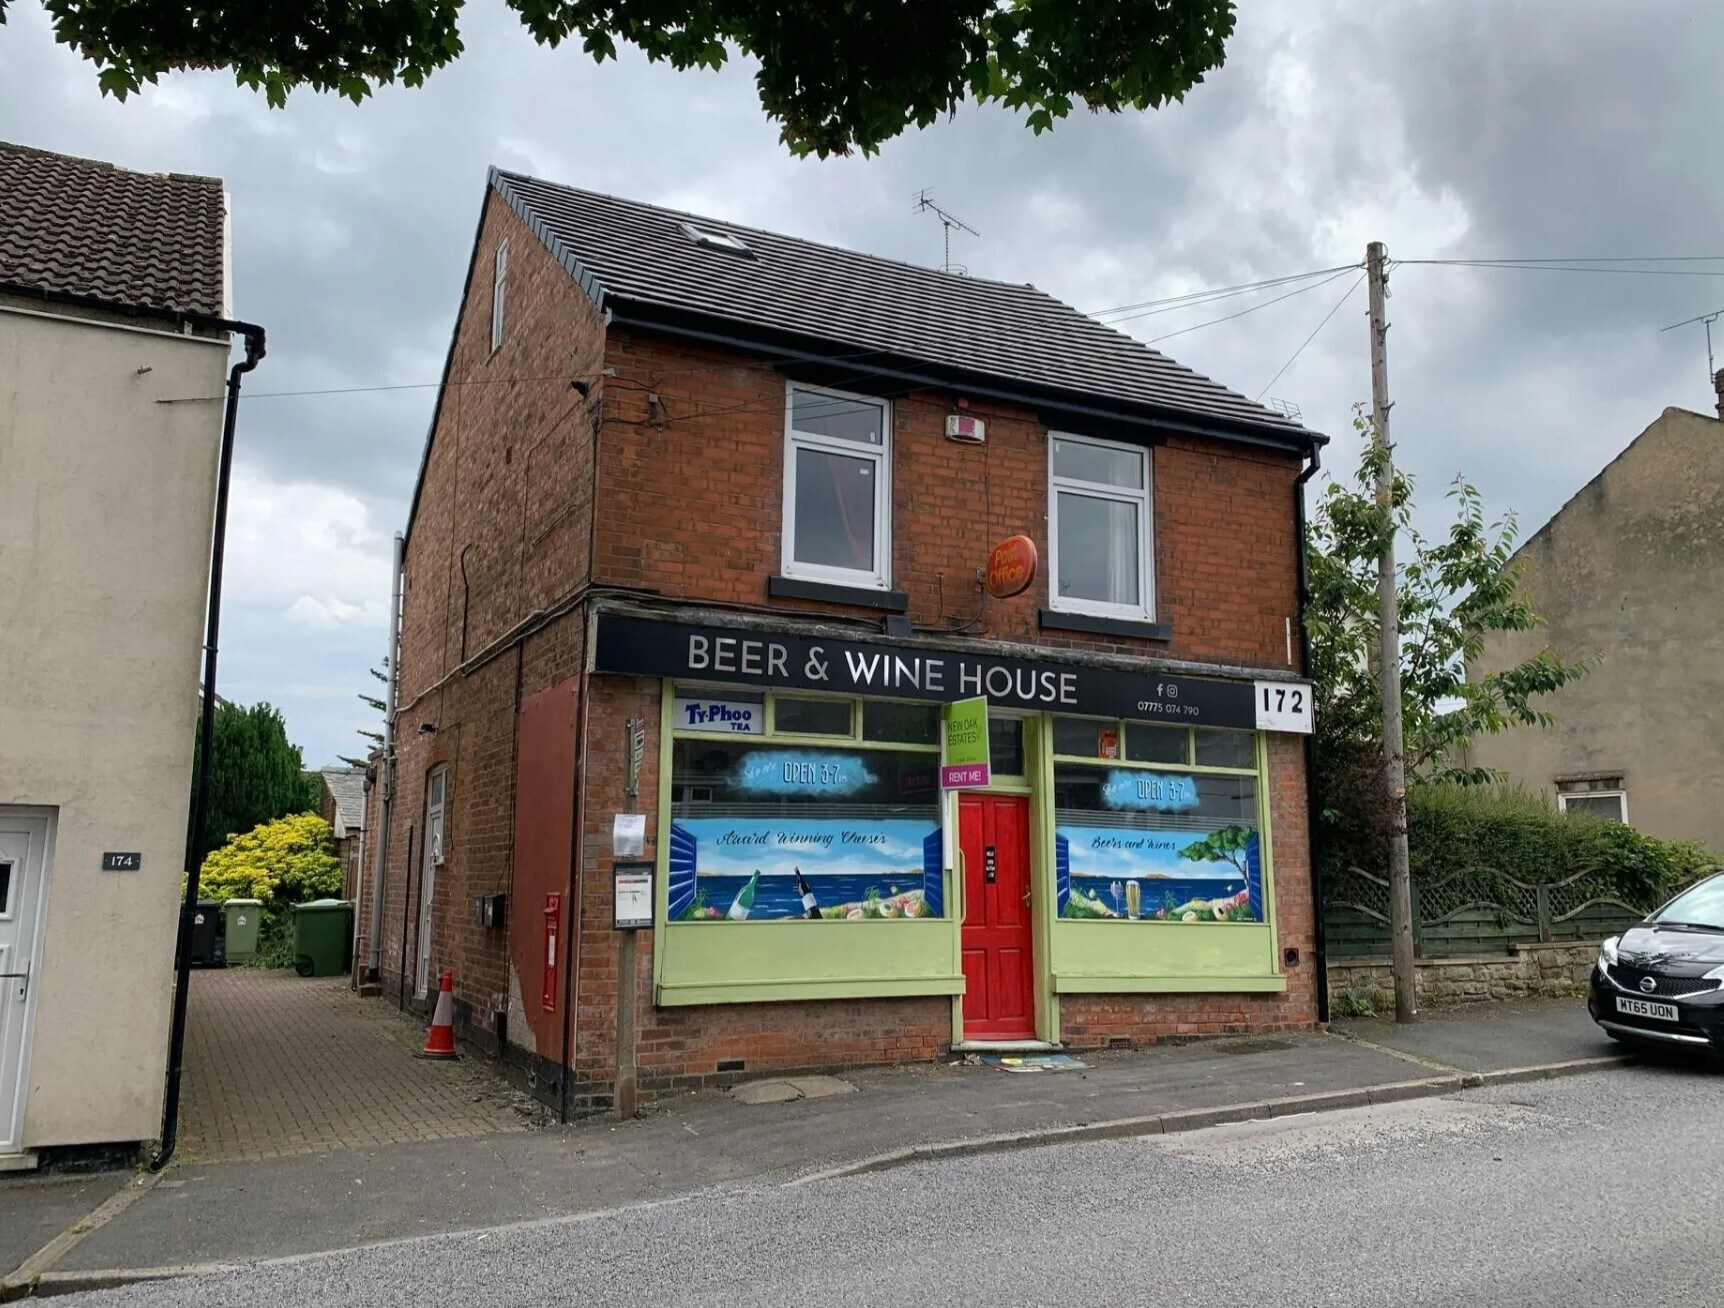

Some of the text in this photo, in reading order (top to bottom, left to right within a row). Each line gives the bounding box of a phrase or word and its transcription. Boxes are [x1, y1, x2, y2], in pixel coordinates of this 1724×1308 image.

[688, 634, 1078, 704] BEER & WINE HOUSE
[1263, 688, 1303, 713] 172
[1138, 701, 1199, 716] 07775 074 790
[730, 722, 751, 731] TEA
[947, 717, 978, 732] NEW OAK
[948, 731, 976, 746] ESTATES
[783, 761, 816, 784] OPEN
[949, 770, 981, 782] RENT ME!
[1137, 779, 1163, 800] OPEN
[716, 830, 770, 845] Award
[777, 831, 834, 848] Winning
[1124, 838, 1144, 849] and
[111, 855, 133, 867] 174
[1620, 999, 1673, 1018] MT65 UON
